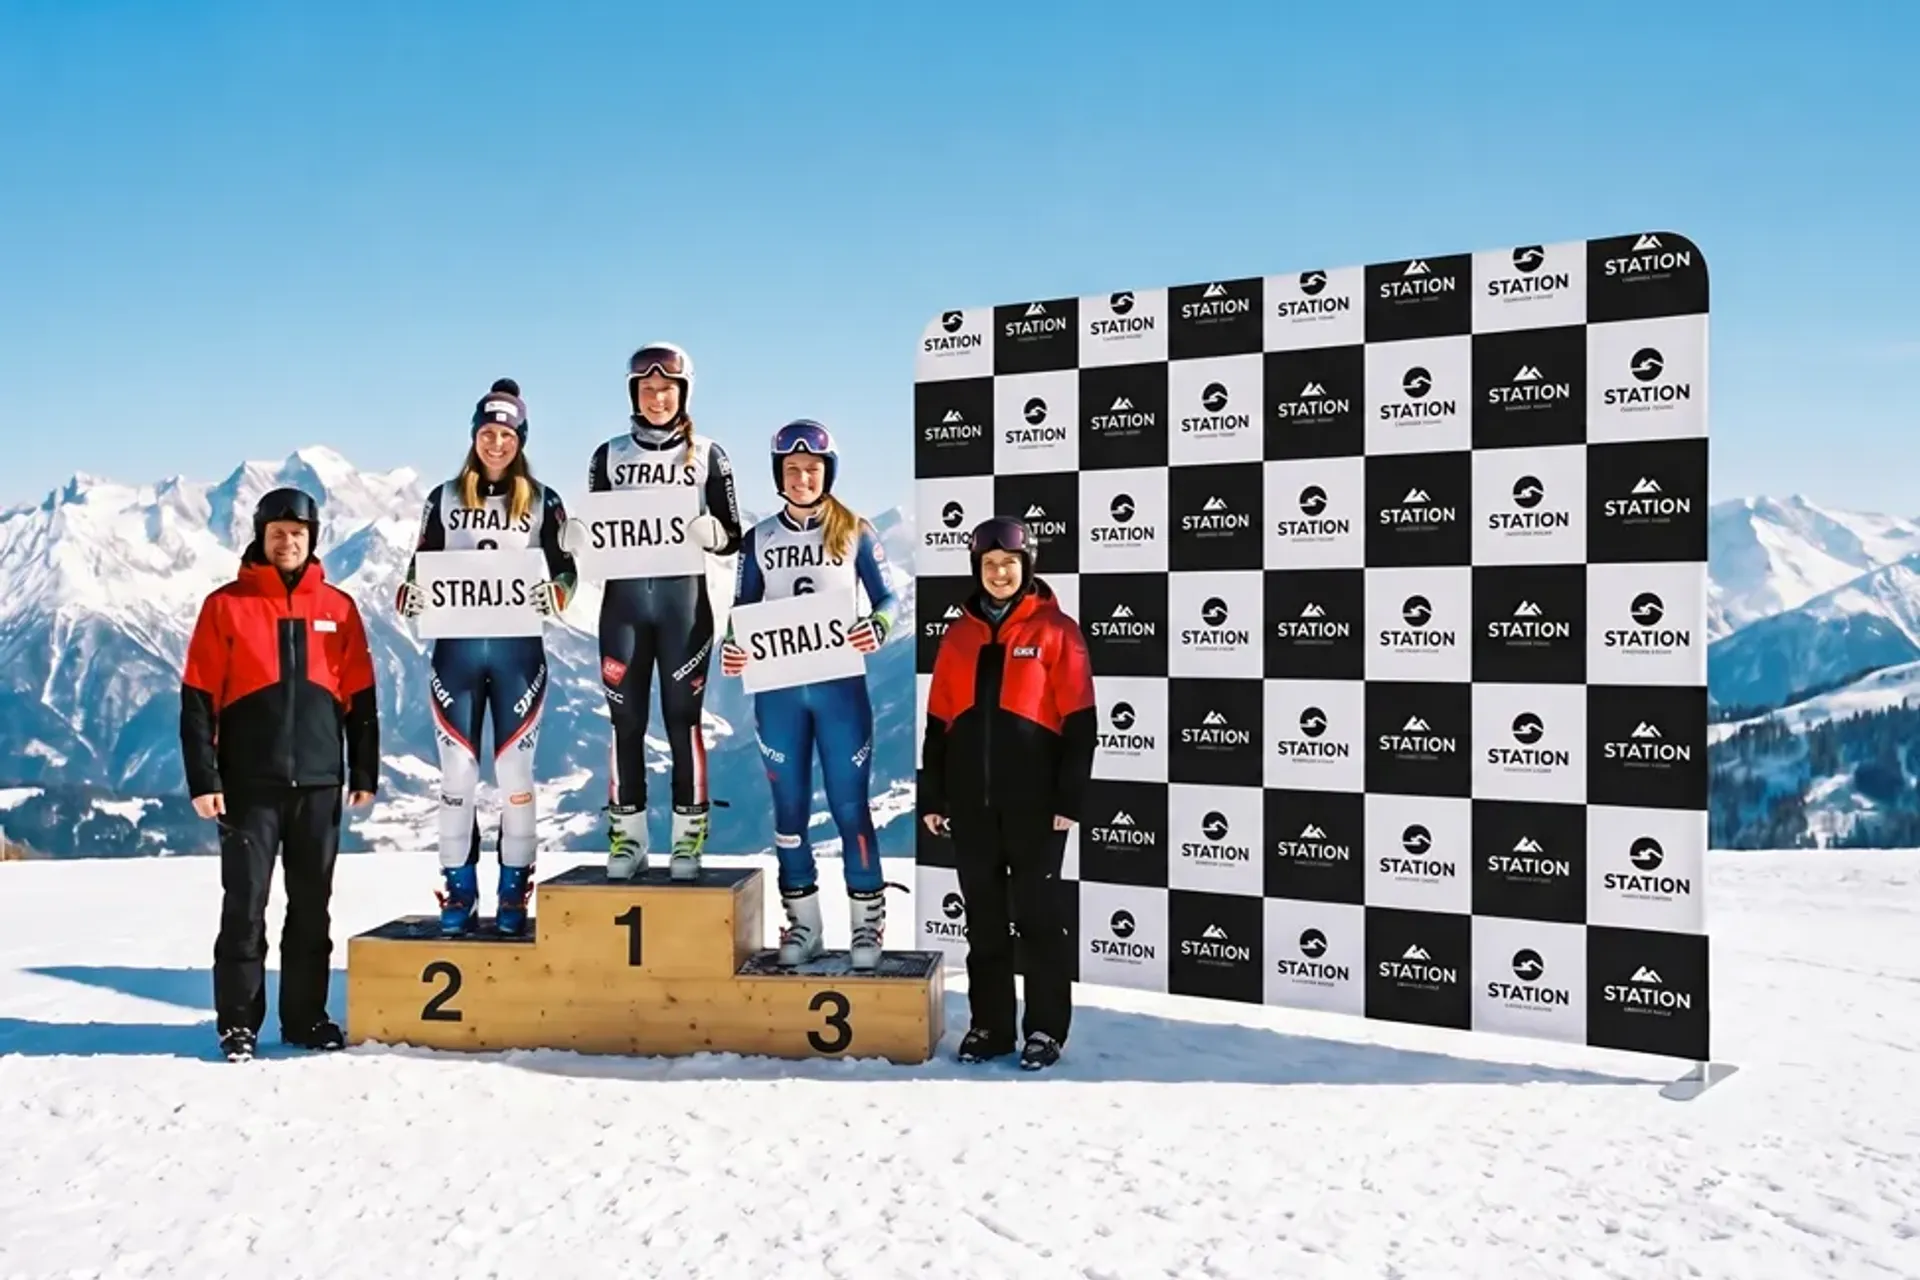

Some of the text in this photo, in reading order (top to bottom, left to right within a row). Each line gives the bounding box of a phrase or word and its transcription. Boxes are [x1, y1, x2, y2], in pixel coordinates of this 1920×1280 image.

[1605, 251, 1690, 276] STATION
[1380, 276, 1455, 298] STATION
[1488, 273, 1569, 296] STATION
[1182, 298, 1249, 318] STATION
[1277, 296, 1350, 317] STATION
[1005, 317, 1066, 337] STATION
[1090, 316, 1155, 336] STATION
[924, 333, 982, 352] STATION
[1489, 383, 1570, 404] STATION
[1604, 383, 1690, 405] STATION
[1278, 399, 1349, 418] STATION
[1380, 400, 1456, 420] STATION
[1091, 412, 1155, 430] STATION
[1181, 414, 1249, 433] STATION
[925, 425, 982, 441] STATION
[1005, 427, 1066, 444] STATION
[614, 463, 695, 486] STRAJ.S
[1380, 507, 1456, 525] STATION
[1605, 498, 1690, 517] STATION
[449, 508, 531, 532] STRAJ.S
[1024, 520, 1066, 536] ATION
[1182, 514, 1249, 530] STATION
[1277, 519, 1349, 537] STATION
[1489, 511, 1569, 530] STATION
[591, 517, 685, 549] STRAJ.S
[924, 531, 972, 547] STATIO
[1090, 526, 1155, 542] STATION
[764, 544, 843, 571] STRAJ.S
[432, 579, 525, 607] STRAJ.S
[1091, 622, 1155, 636] STATION
[1181, 630, 1249, 645] STATION
[1277, 622, 1349, 638] STATION
[1380, 630, 1455, 647] STATION
[1488, 621, 1570, 638] STATION
[1604, 630, 1690, 647] STATION
[751, 619, 845, 661] STRAJ.S
[1096, 733, 1155, 751] TATION
[1181, 728, 1250, 744] STATION
[1379, 735, 1456, 753] STATION
[1277, 740, 1349, 758] STATION
[1487, 748, 1569, 766] STATION
[1604, 742, 1690, 761] STATION
[1091, 827, 1155, 845] STATION
[1181, 843, 1249, 861] STATION
[1278, 841, 1349, 861] STATION
[1379, 857, 1456, 877] STATION
[1488, 855, 1570, 877] STATION
[1604, 873, 1690, 895] STATION
[614, 906, 643, 967] 1
[1090, 939, 1155, 959] STATION
[1181, 940, 1250, 961] STATION
[1277, 959, 1349, 981] STATION
[1379, 961, 1456, 984] STATION
[421, 961, 463, 1022] 2
[1487, 981, 1569, 1005] STATION
[1604, 985, 1691, 1009] STATION
[806, 990, 853, 1053] 3
